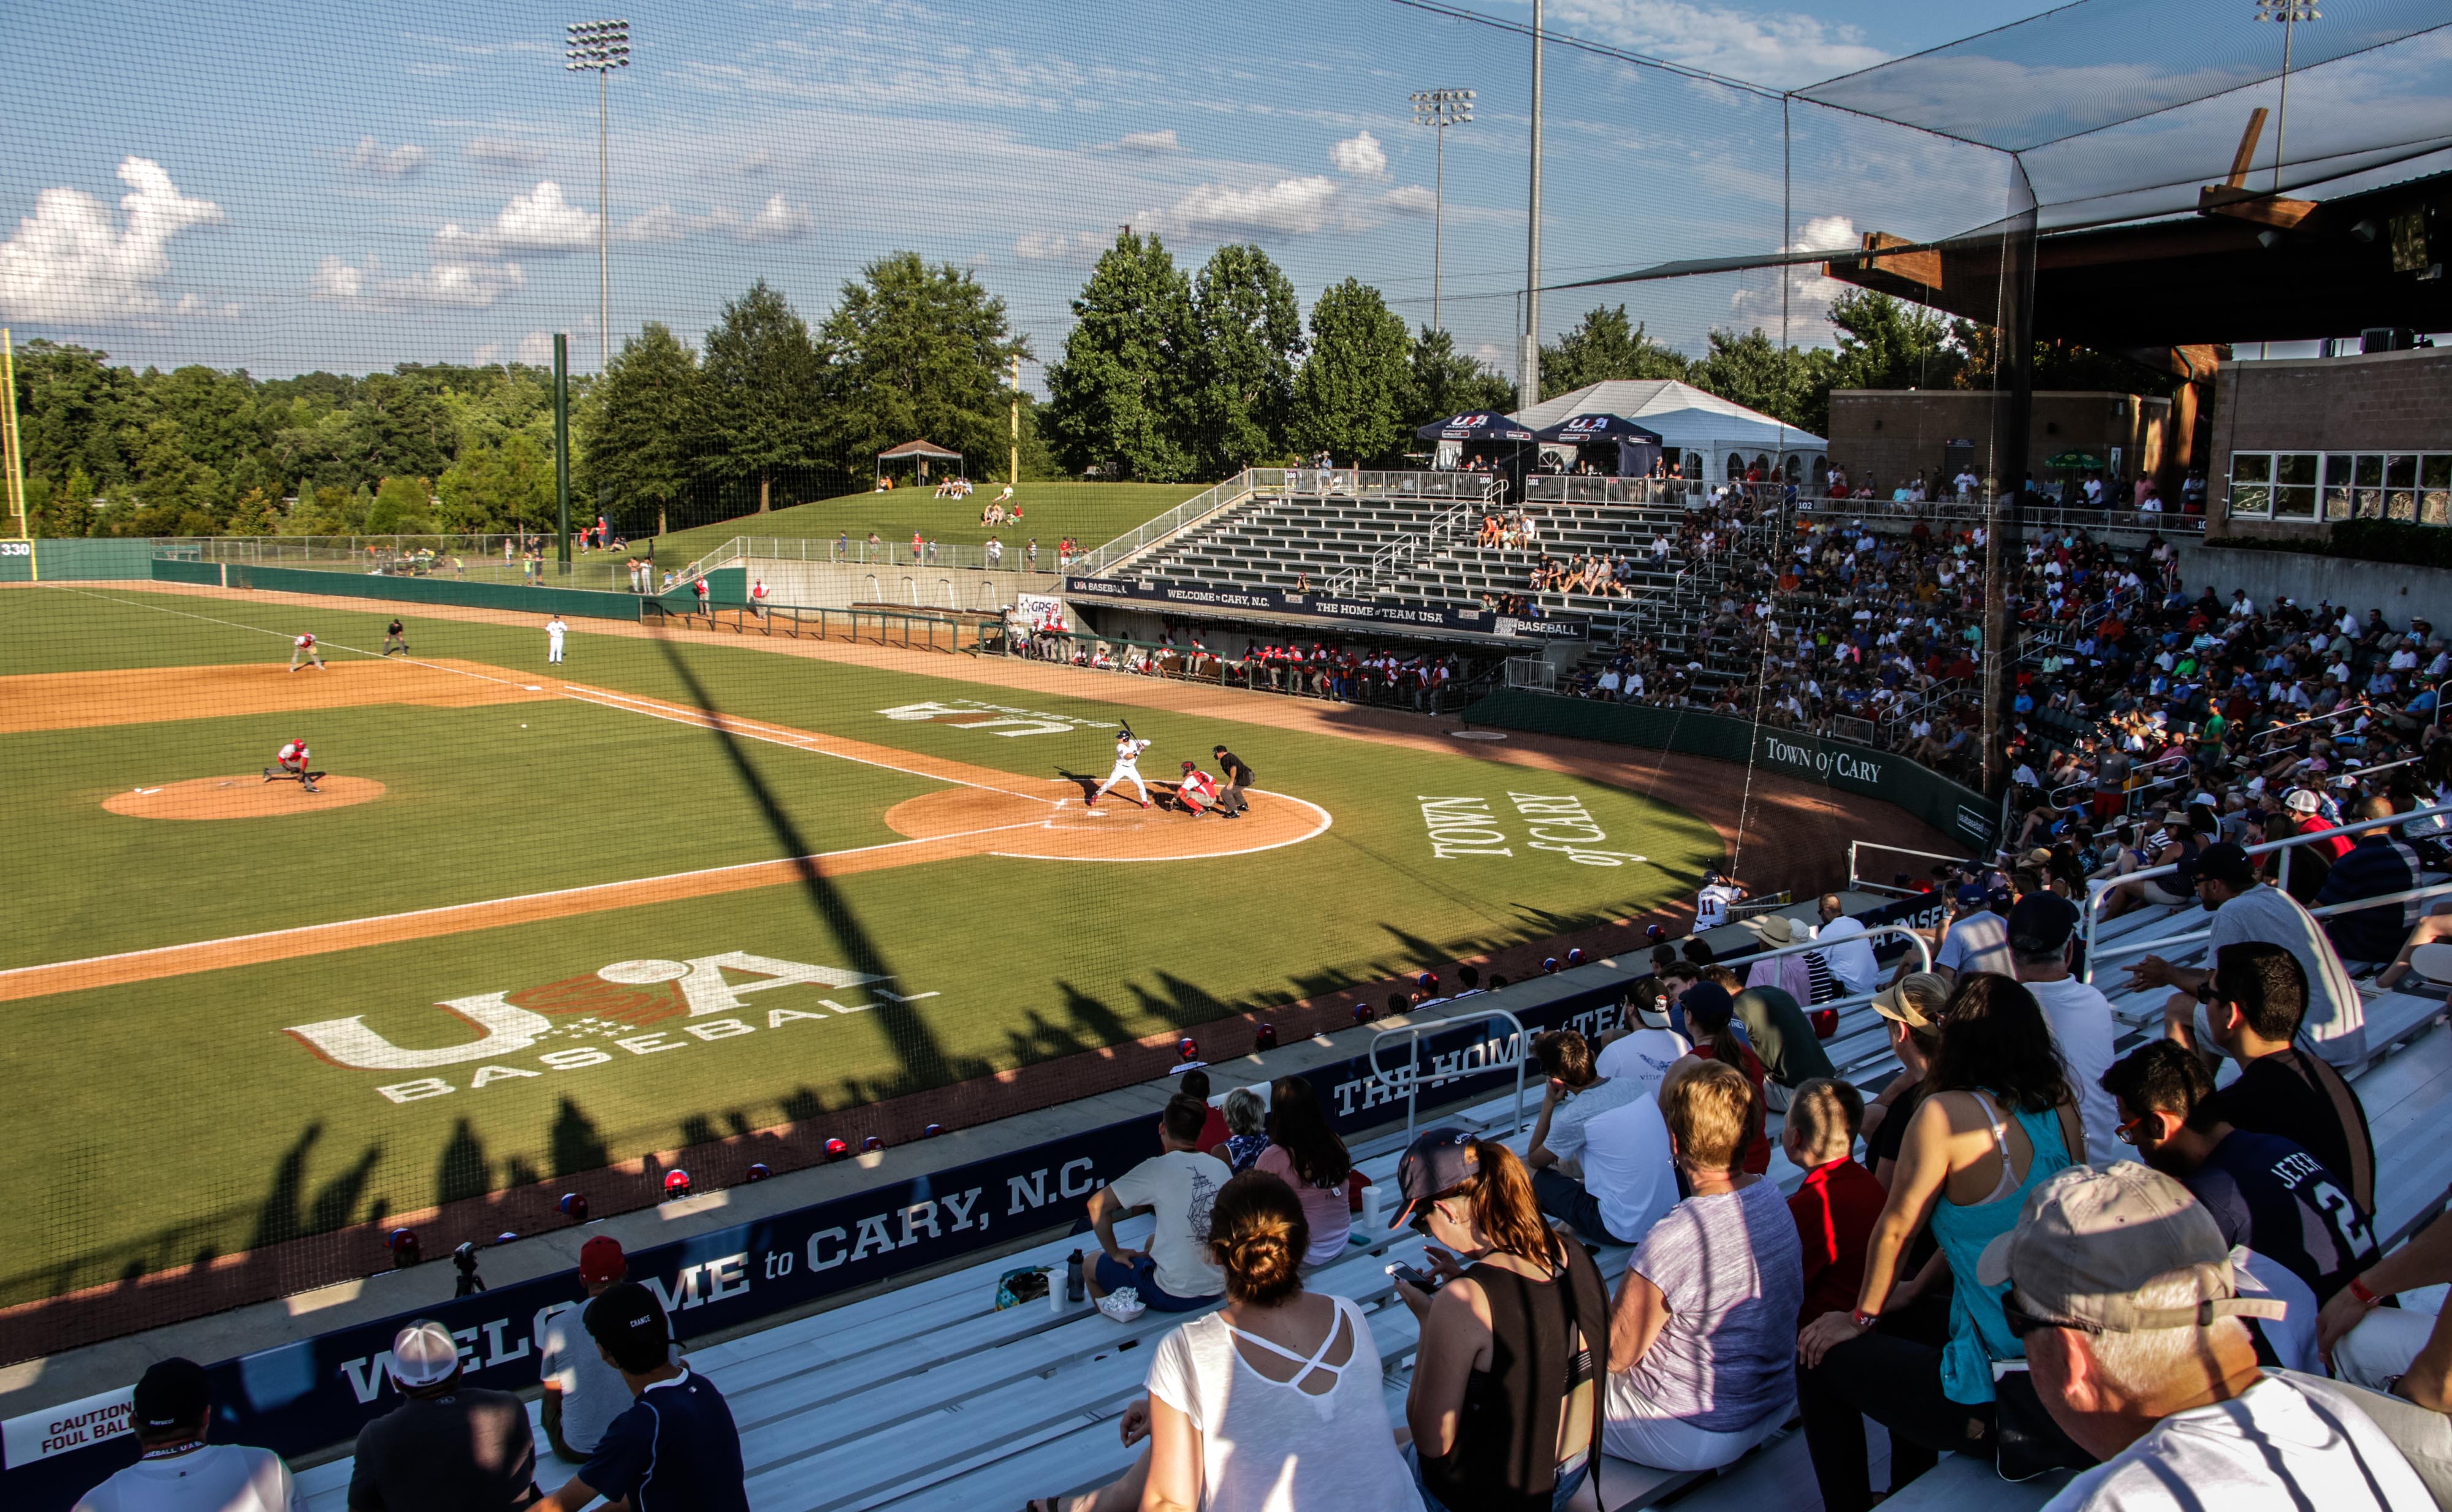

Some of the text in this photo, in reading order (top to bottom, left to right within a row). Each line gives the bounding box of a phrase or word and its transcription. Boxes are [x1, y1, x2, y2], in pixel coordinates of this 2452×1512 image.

[1, 543, 30, 556] 330
[1088, 582, 1127, 594] BASEBALL
[1167, 589, 1215, 602] WELCOME
[1221, 595, 1250, 607] CARY,
[1251, 597, 1270, 607] N.C.
[1031, 601, 1059, 614] GRSA
[1316, 602, 1338, 613] THE
[1340, 604, 1374, 616] HOME
[1381, 608, 1416, 620] TEAM
[1418, 612, 1444, 623] USA
[1517, 620, 1578, 636] BASEBALL
[1765, 737, 1811, 769] TOWN
[1837, 753, 1882, 784] CARY
[1417, 795, 1513, 858] TOWN
[1507, 791, 1606, 842] CARY
[1702, 899, 1715, 916] 11
[375, 988, 941, 1104] BASEBALL
[1334, 1062, 1420, 1117] THE
[2271, 1152, 2323, 1190] JETER
[764, 1250, 793, 1280] to
[807, 1187, 989, 1274] CARY,
[1007, 1157, 1105, 1217] N.C.
[2313, 1180, 2374, 1260] 2
[630, 1315, 652, 1328] CHANCE
[50, 1401, 133, 1435] CAUTION
[42, 1430, 88, 1454] FOUL
